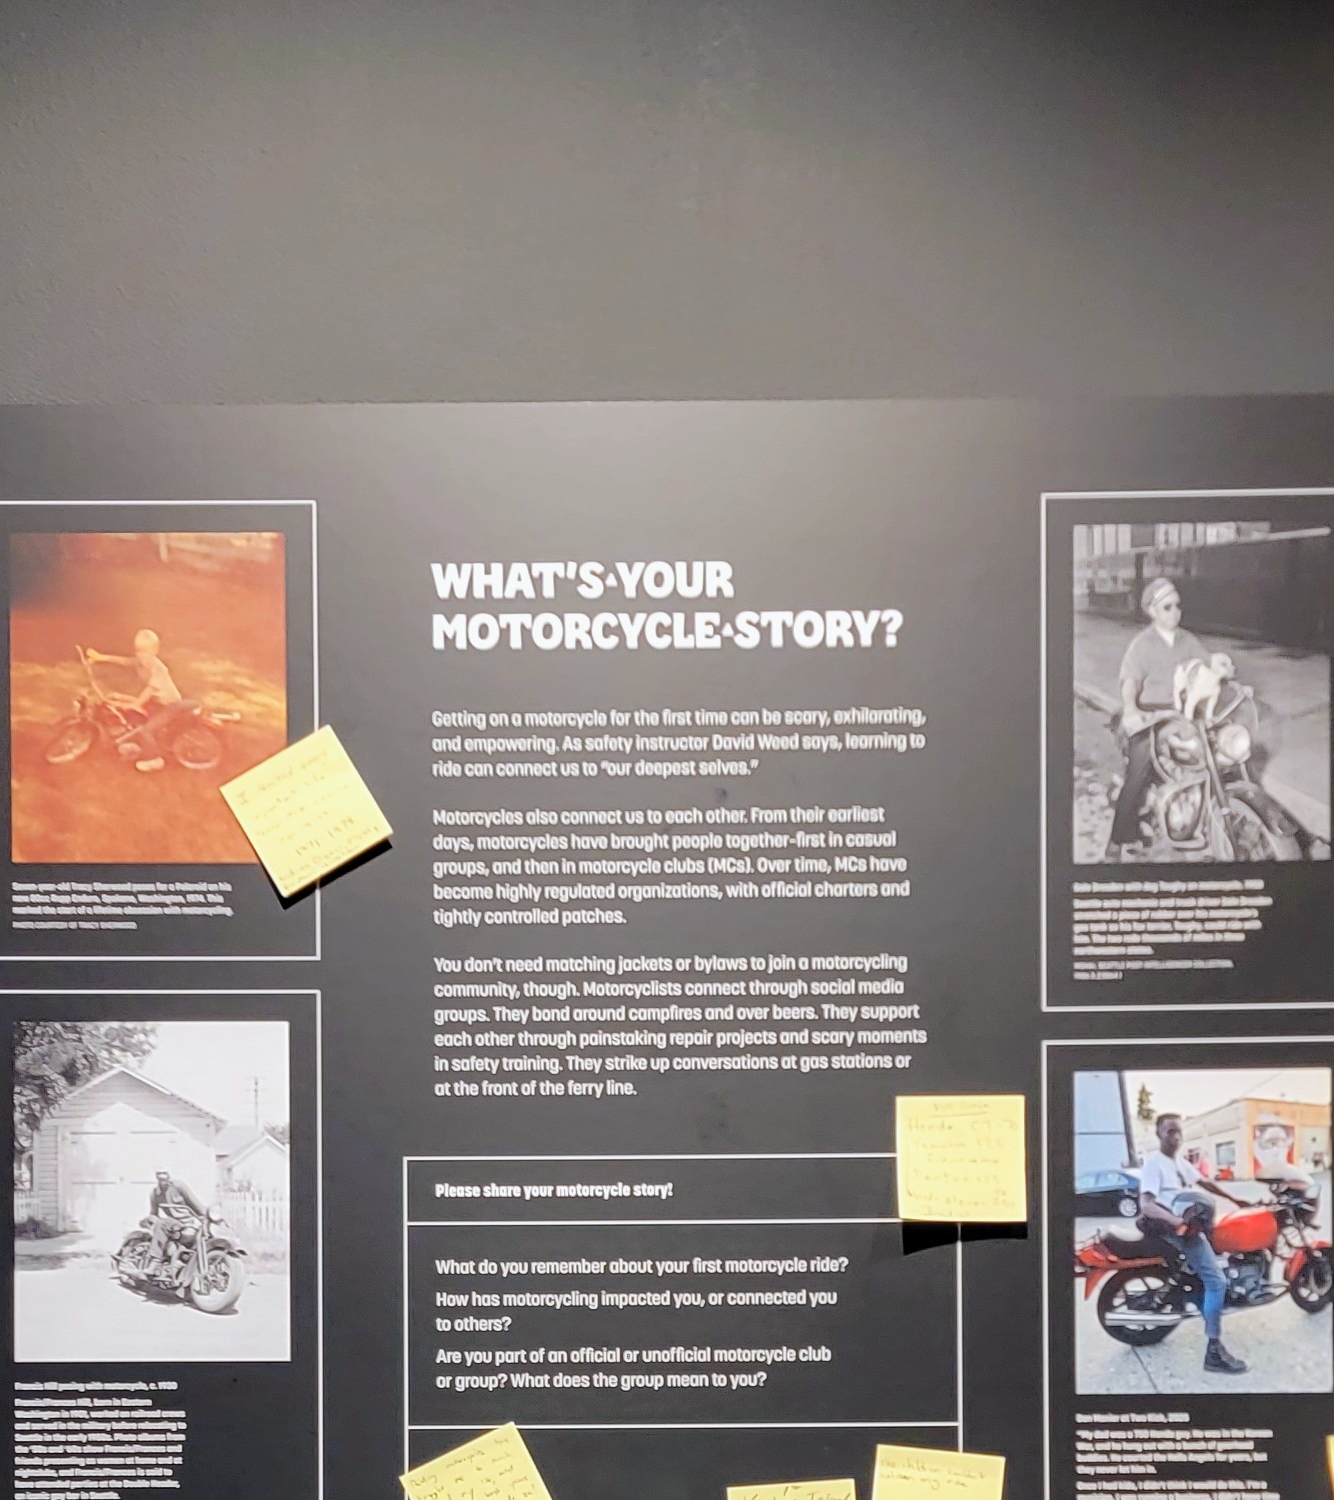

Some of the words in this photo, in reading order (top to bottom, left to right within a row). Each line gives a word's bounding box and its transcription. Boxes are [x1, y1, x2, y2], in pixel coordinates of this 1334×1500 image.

[431, 562, 606, 600] WHAT'S
[620, 561, 735, 599] YOUR
[432, 613, 723, 650] MOTORCYCLE
[735, 610, 903, 649] STORY?
[432, 710, 486, 730] Getting
[489, 713, 509, 726] on
[511, 713, 522, 726] a
[524, 710, 608, 729] motorcycle
[609, 709, 633, 726] for
[633, 709, 660, 726] the
[661, 709, 693, 725] first
[694, 709, 728, 725] time
[730, 712, 760, 725] can
[762, 708, 782, 725] be
[784, 711, 831, 727] scary,
[833, 707, 925, 727] exhilarating,
[432, 736, 461, 751] and
[464, 735, 561, 755] empowering.
[561, 736, 583, 751] As
[584, 734, 633, 754] safety
[635, 734, 710, 750] instructor
[711, 733, 755, 750] David
[757, 733, 799, 750] Weed
[802, 736, 842, 752] says,
[845, 732, 907, 752] learning
[910, 733, 925, 748] to
[432, 760, 462, 776] ride
[464, 764, 494, 776] can
[496, 762, 558, 776] connect
[560, 763, 580, 776] us
[582, 762, 598, 776] to
[634, 759, 696, 779] deepest
[433, 809, 523, 828] Motorcycles
[525, 808, 559, 824] also
[560, 810, 623, 824] connect
[624, 811, 645, 824] us
[646, 810, 663, 824] to
[664, 808, 703, 823] each
[705, 807, 748, 823] other.
[750, 807, 787, 823] From
[789, 806, 825, 822] their
[827, 806, 884, 822] earliest
[433, 834, 474, 853] days,
[477, 834, 568, 853] motorcycles
[570, 833, 608, 849] have
[610, 833, 669, 852] brought
[671, 832, 723, 851] people
[828, 831, 843, 847] in
[845, 831, 896, 847] casual
[435, 1183, 481, 1197] Please
[483, 1183, 521, 1197] share
[523, 1186, 554, 1200] your
[555, 1182, 631, 1199] motorcycle
[633, 1183, 673, 1199] story!
[435, 1259, 476, 1274] What
[478, 1259, 498, 1274] do
[499, 1262, 529, 1277] you
[530, 1259, 607, 1273] remember
[608, 1258, 653, 1273] about
[654, 1261, 690, 1276] your
[692, 1257, 722, 1273] first
[724, 1257, 807, 1275] motorcycle
[810, 1257, 848, 1272] ride?
[436, 1292, 469, 1306] How
[471, 1292, 500, 1306] has
[502, 1291, 599, 1309] motorcycling
[601, 1290, 671, 1308] impacted
[673, 1293, 705, 1308] you,
[707, 1293, 725, 1305] or
[726, 1290, 807, 1304] connected
[809, 1292, 837, 1307] you
[436, 1318, 451, 1331] to
[454, 1316, 512, 1331] others?
[436, 1349, 462, 1363] Are
[464, 1351, 493, 1366] you
[494, 1350, 527, 1366] part
[529, 1348, 546, 1363] of
[546, 1351, 568, 1363] an
[570, 1347, 621, 1362] official
[623, 1350, 641, 1362] or
[641, 1347, 711, 1362] unofficial
[713, 1346, 796, 1364] motorcycle
[798, 1346, 831, 1361] club
[436, 1376, 453, 1388] or
[455, 1374, 508, 1391] group?
[509, 1373, 551, 1387] What
[551, 1372, 590, 1387] does
[592, 1372, 618, 1387] the
[619, 1375, 664, 1390] group
[666, 1375, 709, 1386] mean
[711, 1373, 727, 1386] to
[729, 1372, 767, 1389] you?
